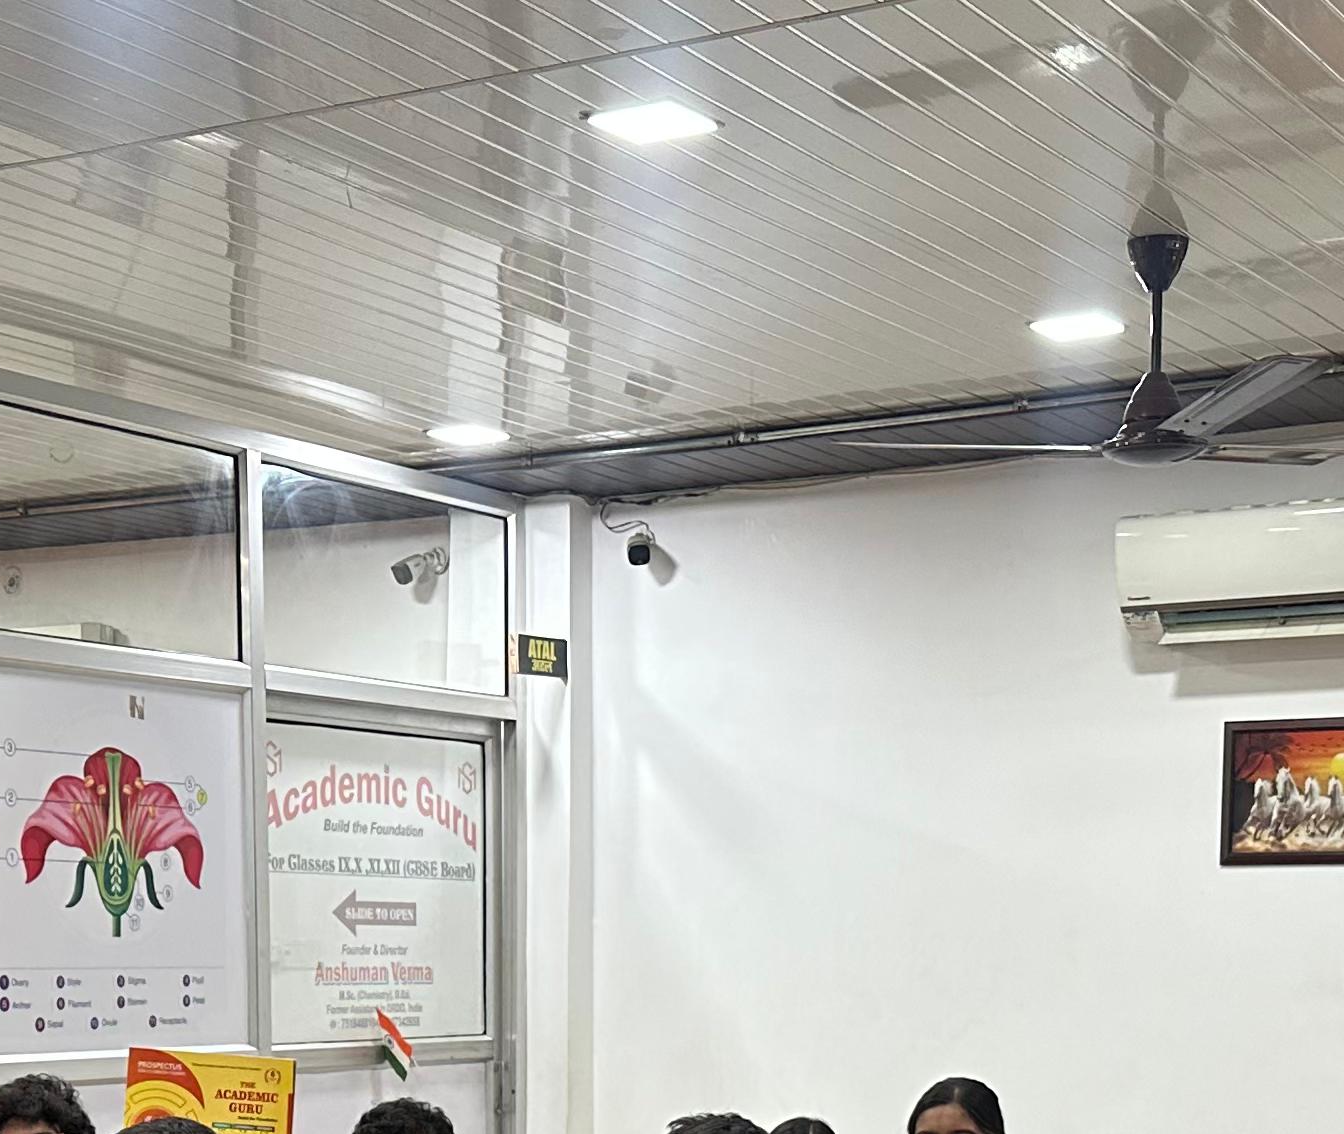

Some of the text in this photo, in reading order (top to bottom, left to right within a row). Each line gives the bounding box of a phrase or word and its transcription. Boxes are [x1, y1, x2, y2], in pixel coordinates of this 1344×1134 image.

[528, 639, 557, 661] ATAL
[416, 777, 477, 851] Guru
[323, 819, 423, 837] Build the Foundation
[269, 853, 284, 869] or
[389, 909, 415, 920] OPEN
[315, 962, 433, 983] Anshuman Verma
[214, 1089, 279, 1104] ACADEMIC
[228, 1102, 263, 1115] GURU
